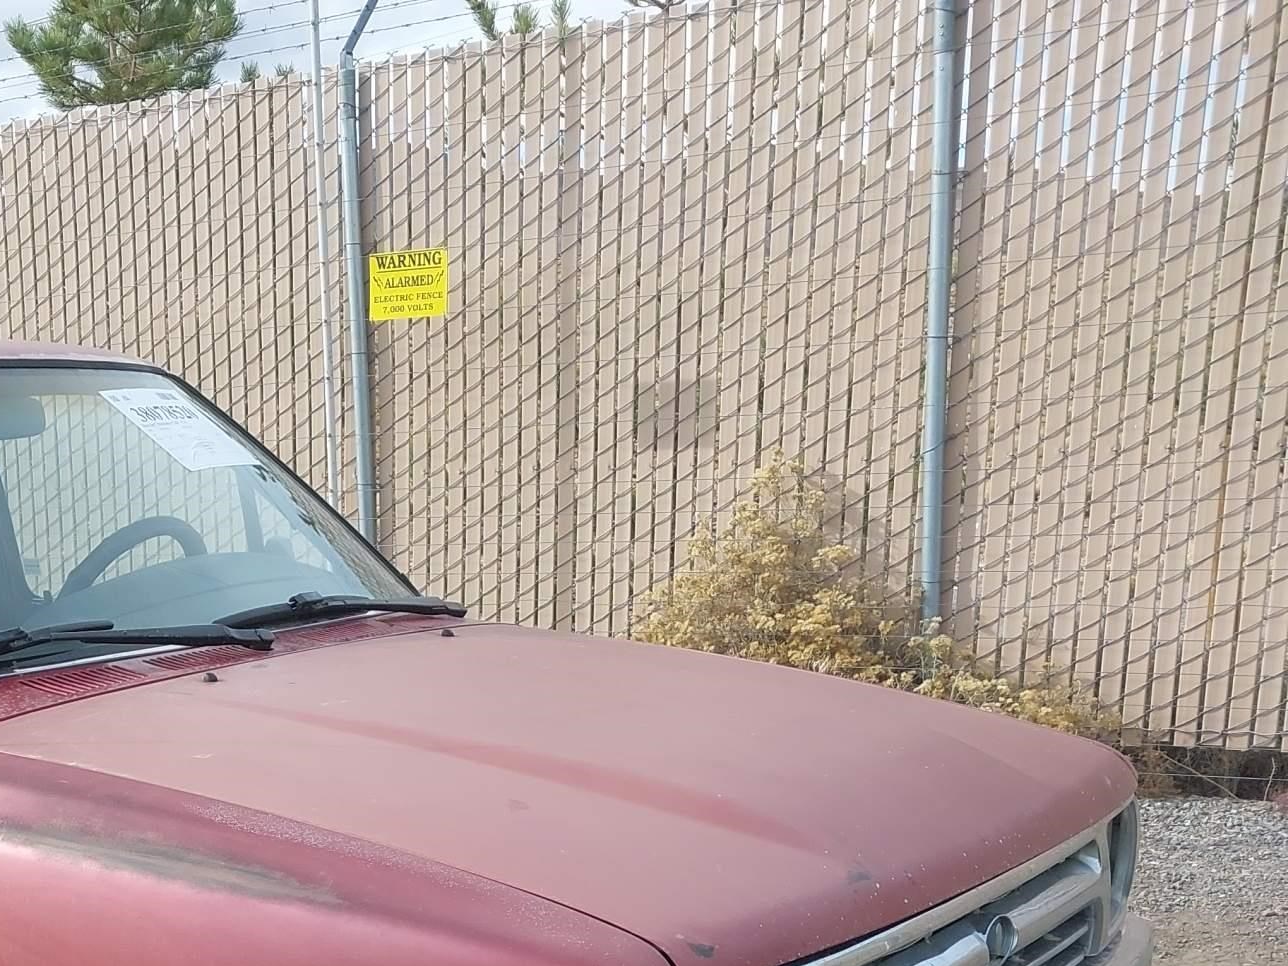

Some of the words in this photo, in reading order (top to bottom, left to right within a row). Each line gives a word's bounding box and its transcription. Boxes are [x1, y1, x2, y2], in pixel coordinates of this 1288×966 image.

[375, 251, 442, 270] WARNING
[384, 274, 434, 289] ALARMED
[373, 293, 415, 304] ELECTRIC
[416, 291, 443, 301] FENCE
[382, 305, 405, 314] 7,000
[407, 303, 434, 312] VOLTS
